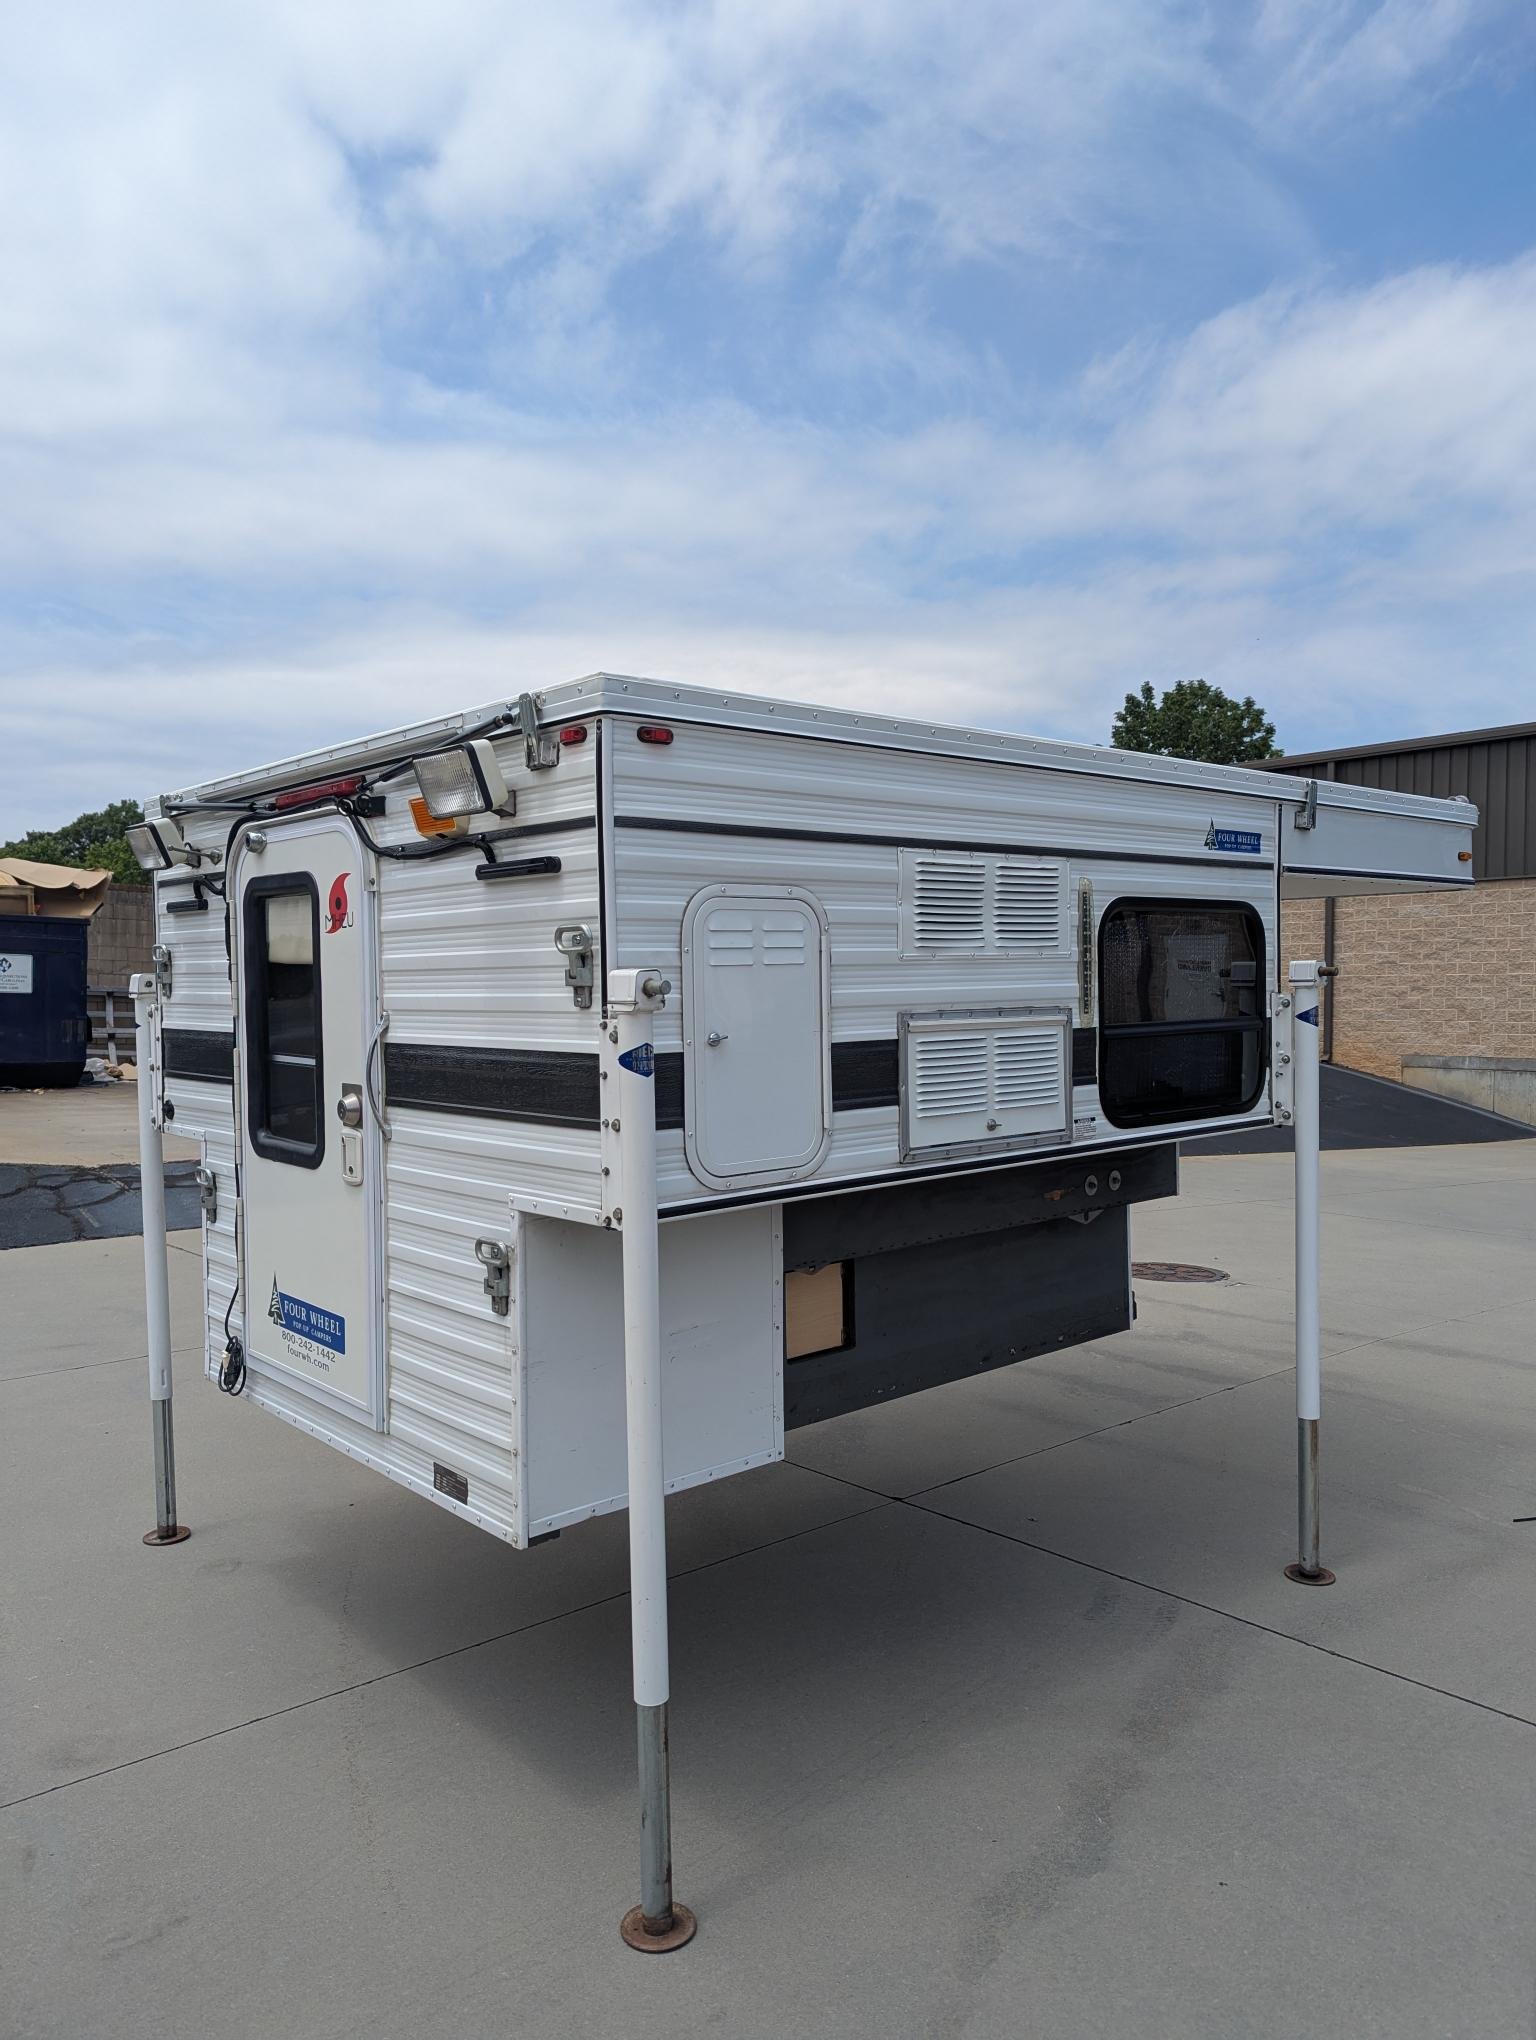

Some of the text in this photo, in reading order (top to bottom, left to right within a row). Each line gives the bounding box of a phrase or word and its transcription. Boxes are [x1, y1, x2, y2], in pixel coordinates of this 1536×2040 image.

[284, 1300, 342, 1336] FOUR WHEEL
[281, 1330, 336, 1363] 800-242-1442
[310, 1328, 332, 1343] CAMPERS
[287, 1344, 330, 1372] fourwh.com
